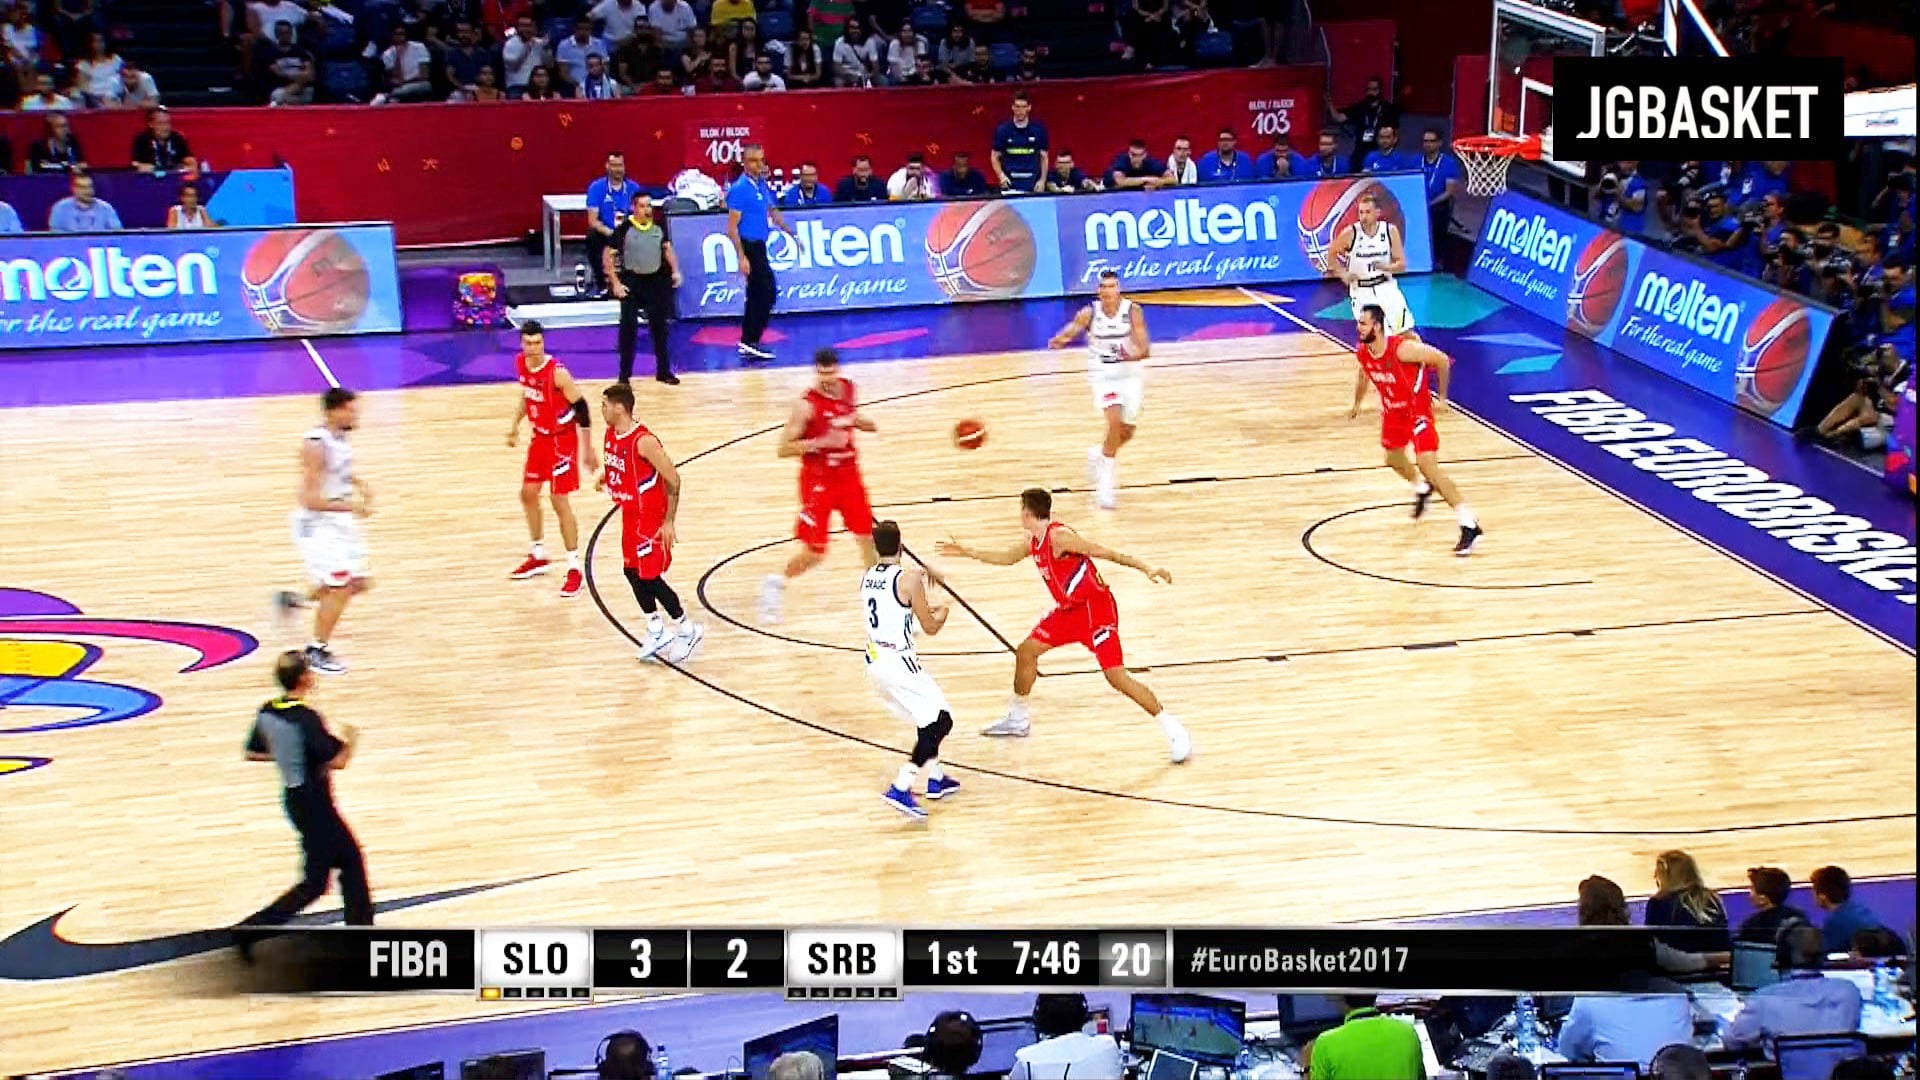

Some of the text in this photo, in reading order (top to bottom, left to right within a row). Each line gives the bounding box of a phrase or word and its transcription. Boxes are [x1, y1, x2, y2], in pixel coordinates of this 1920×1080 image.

[1251, 109, 1291, 135] 103
[705, 138, 744, 164] 104
[1085, 199, 1278, 251] molten
[1487, 208, 1573, 273] molten
[1124, 255, 1160, 279] the
[1164, 251, 1215, 276] real
[1215, 254, 1280, 281] game
[1474, 249, 1557, 300] For the real game
[700, 281, 742, 306] For
[787, 274, 839, 298] real
[840, 278, 908, 305] game
[27, 309, 73, 333] the
[79, 305, 141, 331] real
[142, 310, 224, 338] game
[1634, 272, 1740, 344] molten
[1620, 315, 1722, 373] For the real game
[868, 597, 879, 628] 3
